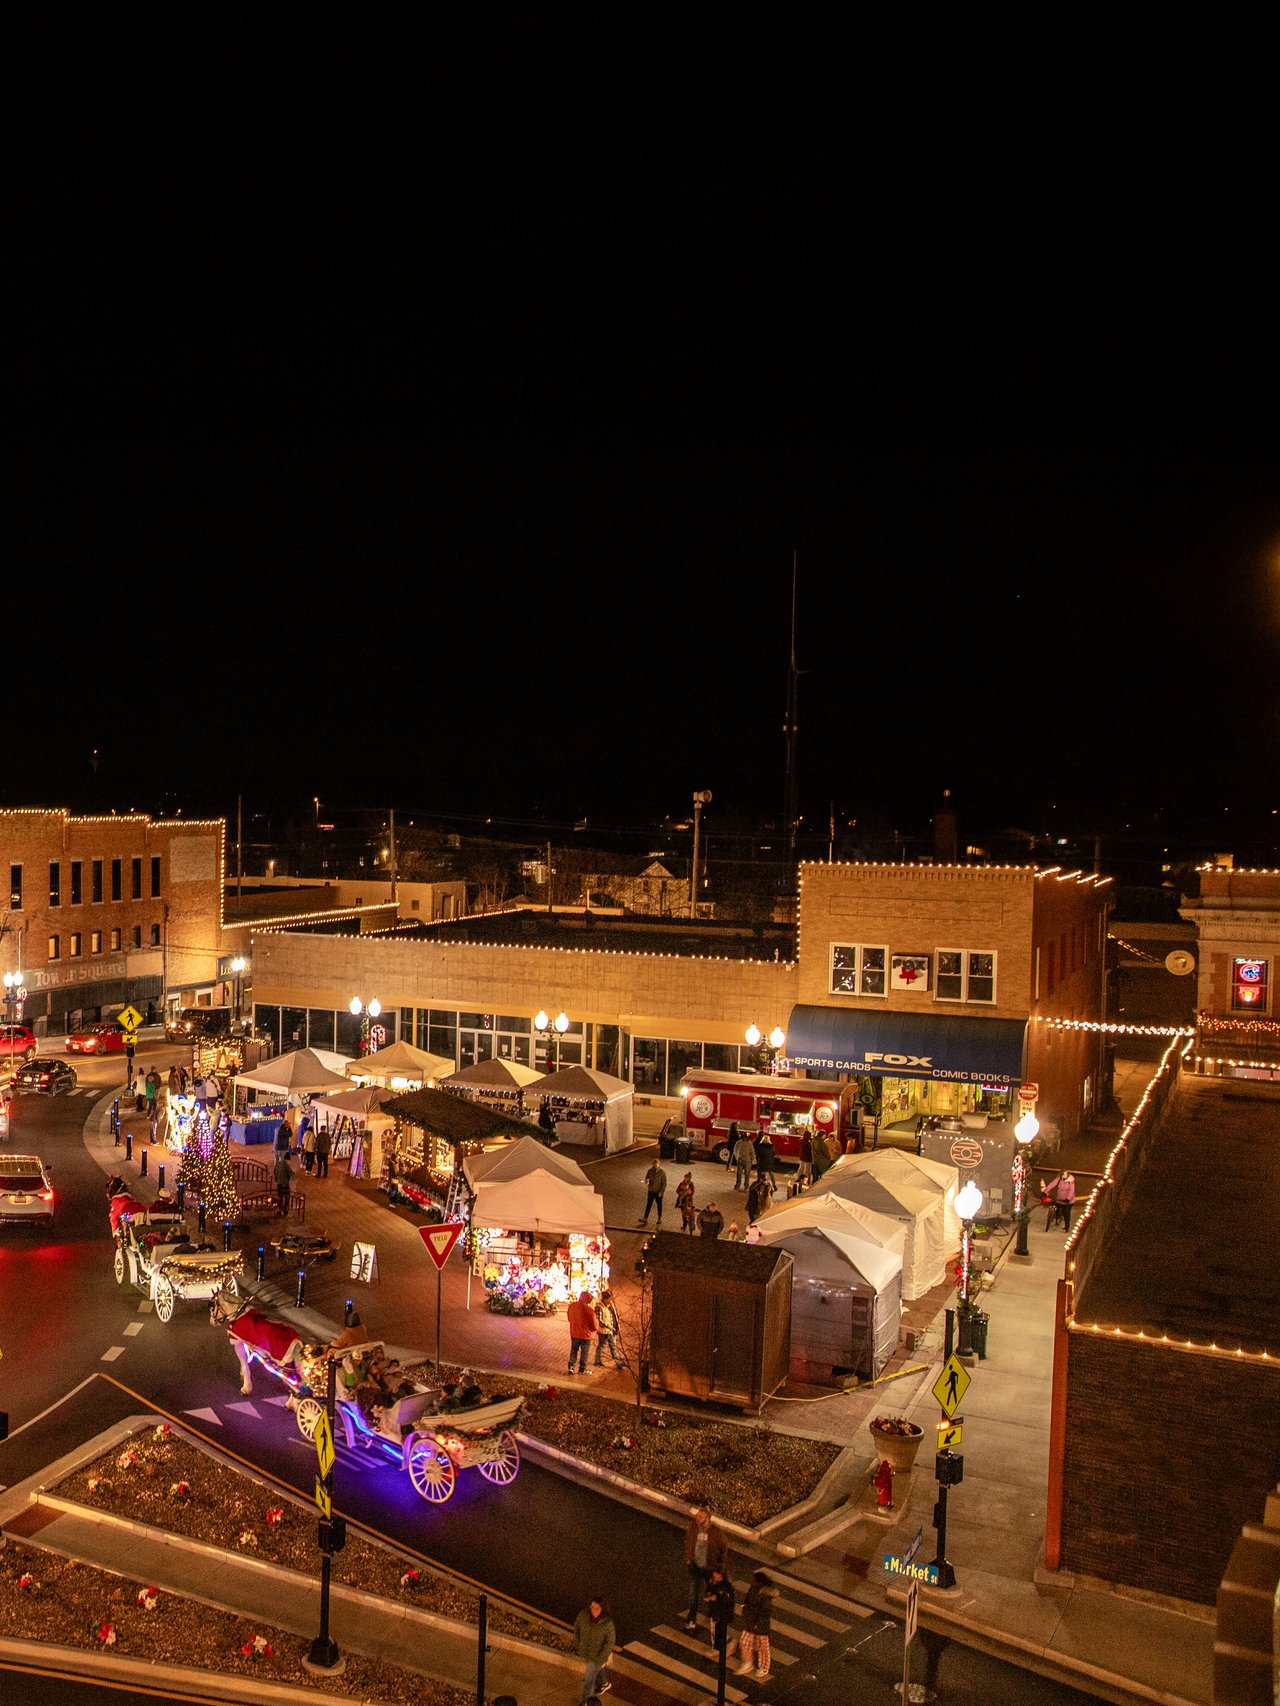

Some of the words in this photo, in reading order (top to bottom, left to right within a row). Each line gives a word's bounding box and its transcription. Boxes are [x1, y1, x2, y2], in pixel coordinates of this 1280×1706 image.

[892, 959, 926, 971] FOX
[794, 1057, 834, 1068] SPORTS
[836, 1061, 871, 1071] CARDS
[864, 1052, 933, 1068] FOX
[932, 1069, 969, 1080] COMIC
[971, 1072, 1011, 1083] BOOKS
[884, 1561, 889, 1570] S
[930, 1574, 938, 1585] St
